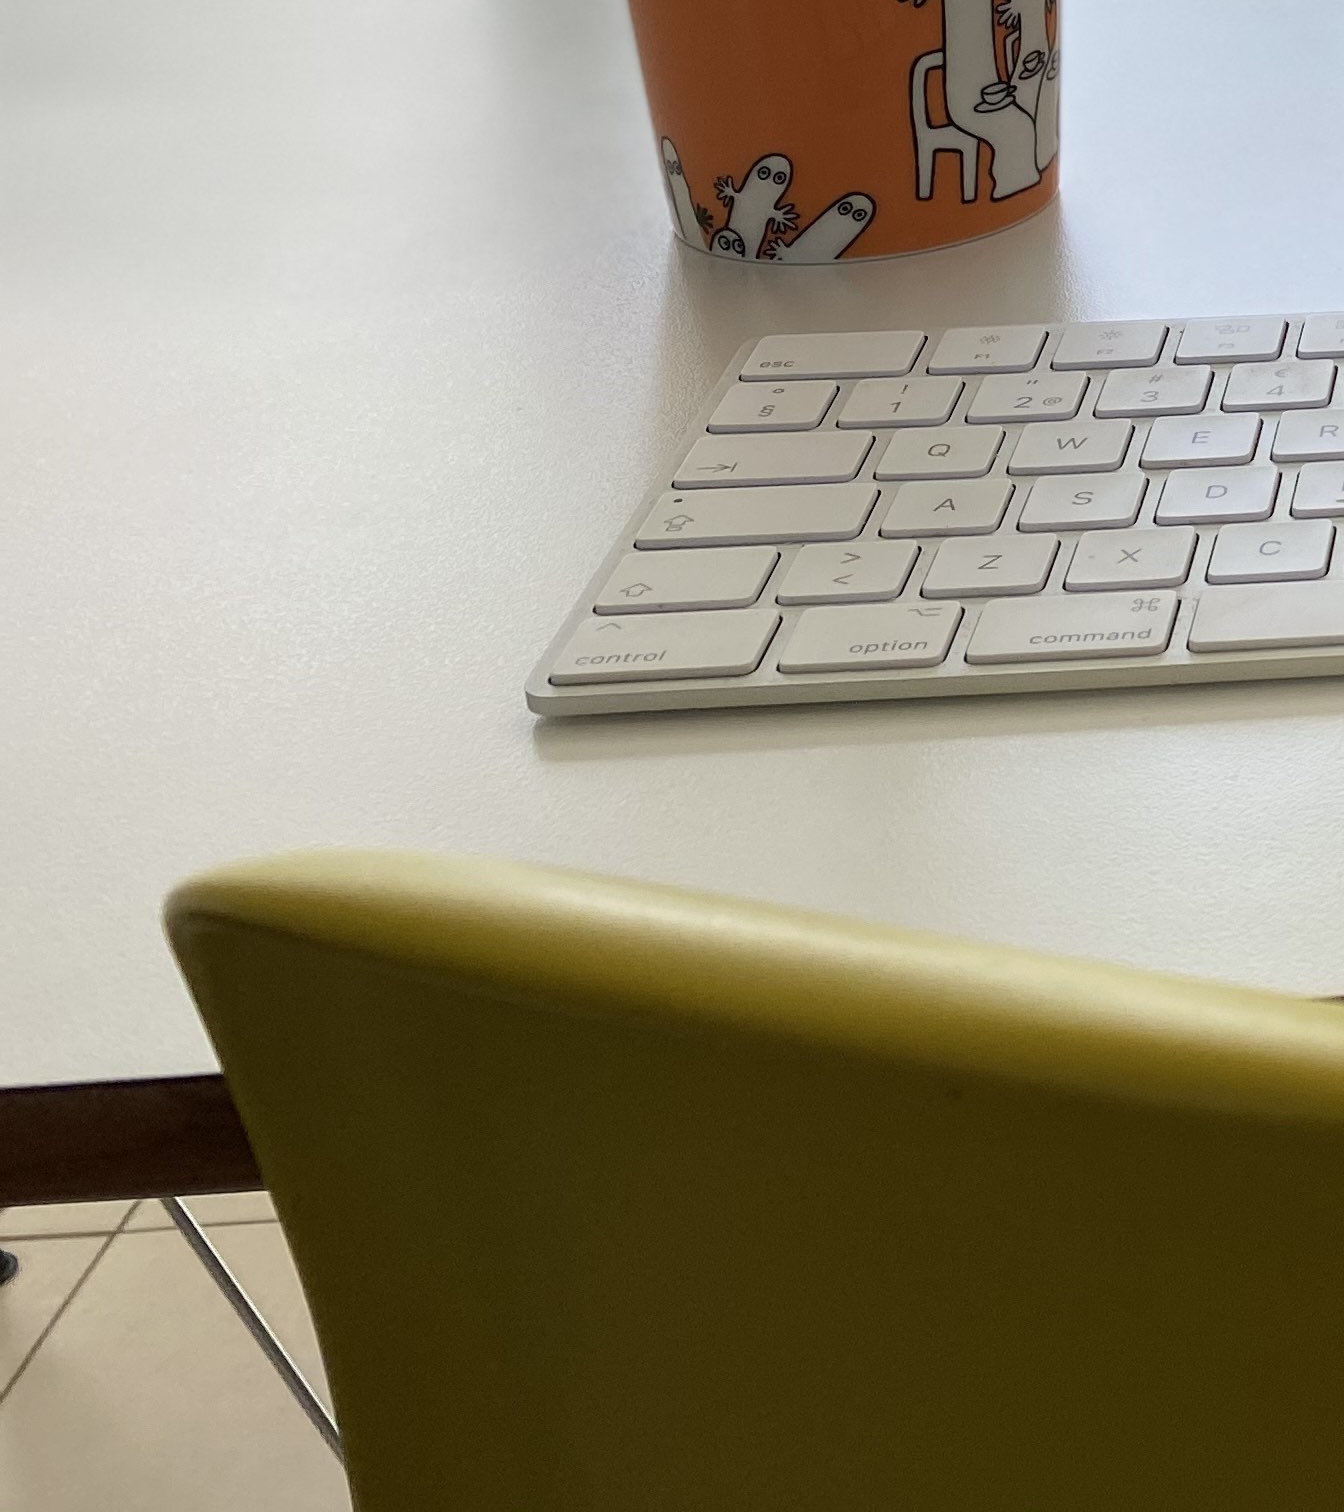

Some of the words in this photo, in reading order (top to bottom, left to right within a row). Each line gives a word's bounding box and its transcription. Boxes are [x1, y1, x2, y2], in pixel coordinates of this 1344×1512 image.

[759, 360, 795, 369] esc
[1140, 390, 1160, 403] 3
[1266, 384, 1285, 397] 4
[1013, 396, 1033, 409] 2
[1191, 430, 1211, 444] E
[1319, 424, 1340, 438] R
[927, 443, 951, 458] Q
[1056, 437, 1089, 450] W
[1071, 491, 1094, 506] S
[1205, 484, 1228, 499] D
[932, 498, 956, 512] A
[1258, 540, 1282, 556] C
[977, 554, 1003, 570] Z
[1117, 548, 1142, 564] X
[1029, 626, 1152, 645] command
[849, 638, 928, 657] option
[575, 649, 667, 666] control
